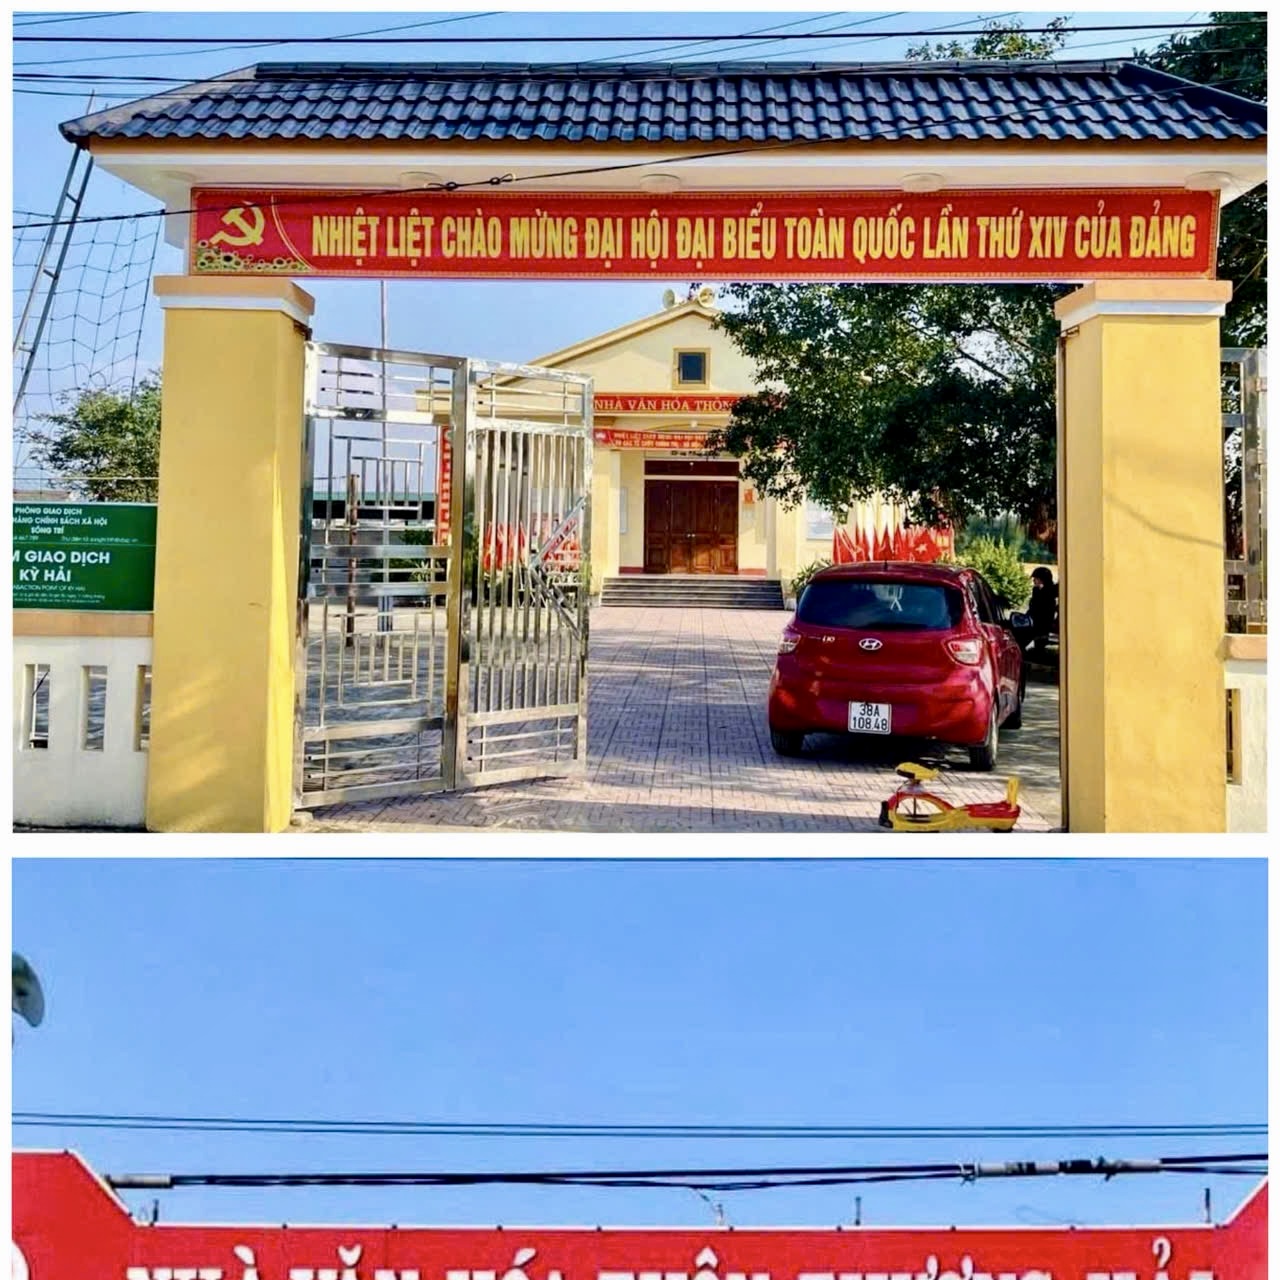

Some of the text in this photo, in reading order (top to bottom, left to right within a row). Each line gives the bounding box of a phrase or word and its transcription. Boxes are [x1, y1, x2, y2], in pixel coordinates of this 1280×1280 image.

[312, 200, 1197, 268] NHIỆT LIỆT CHÀO MỪNG ĐẠI HỘI ĐẠI BIỂU TOÀN QUỐC LẦN THỨ XIV CỦA ĐẢNG
[594, 397, 623, 410] NHÀ
[628, 398, 657, 410] VĂN
[661, 398, 689, 411] HÓA
[25, 550, 66, 563] GIAO
[70, 551, 111, 566] DỊCH
[19, 565, 71, 582] KỲ HẢI
[859, 704, 880, 717] 38A
[853, 717, 888, 730] 108.48
